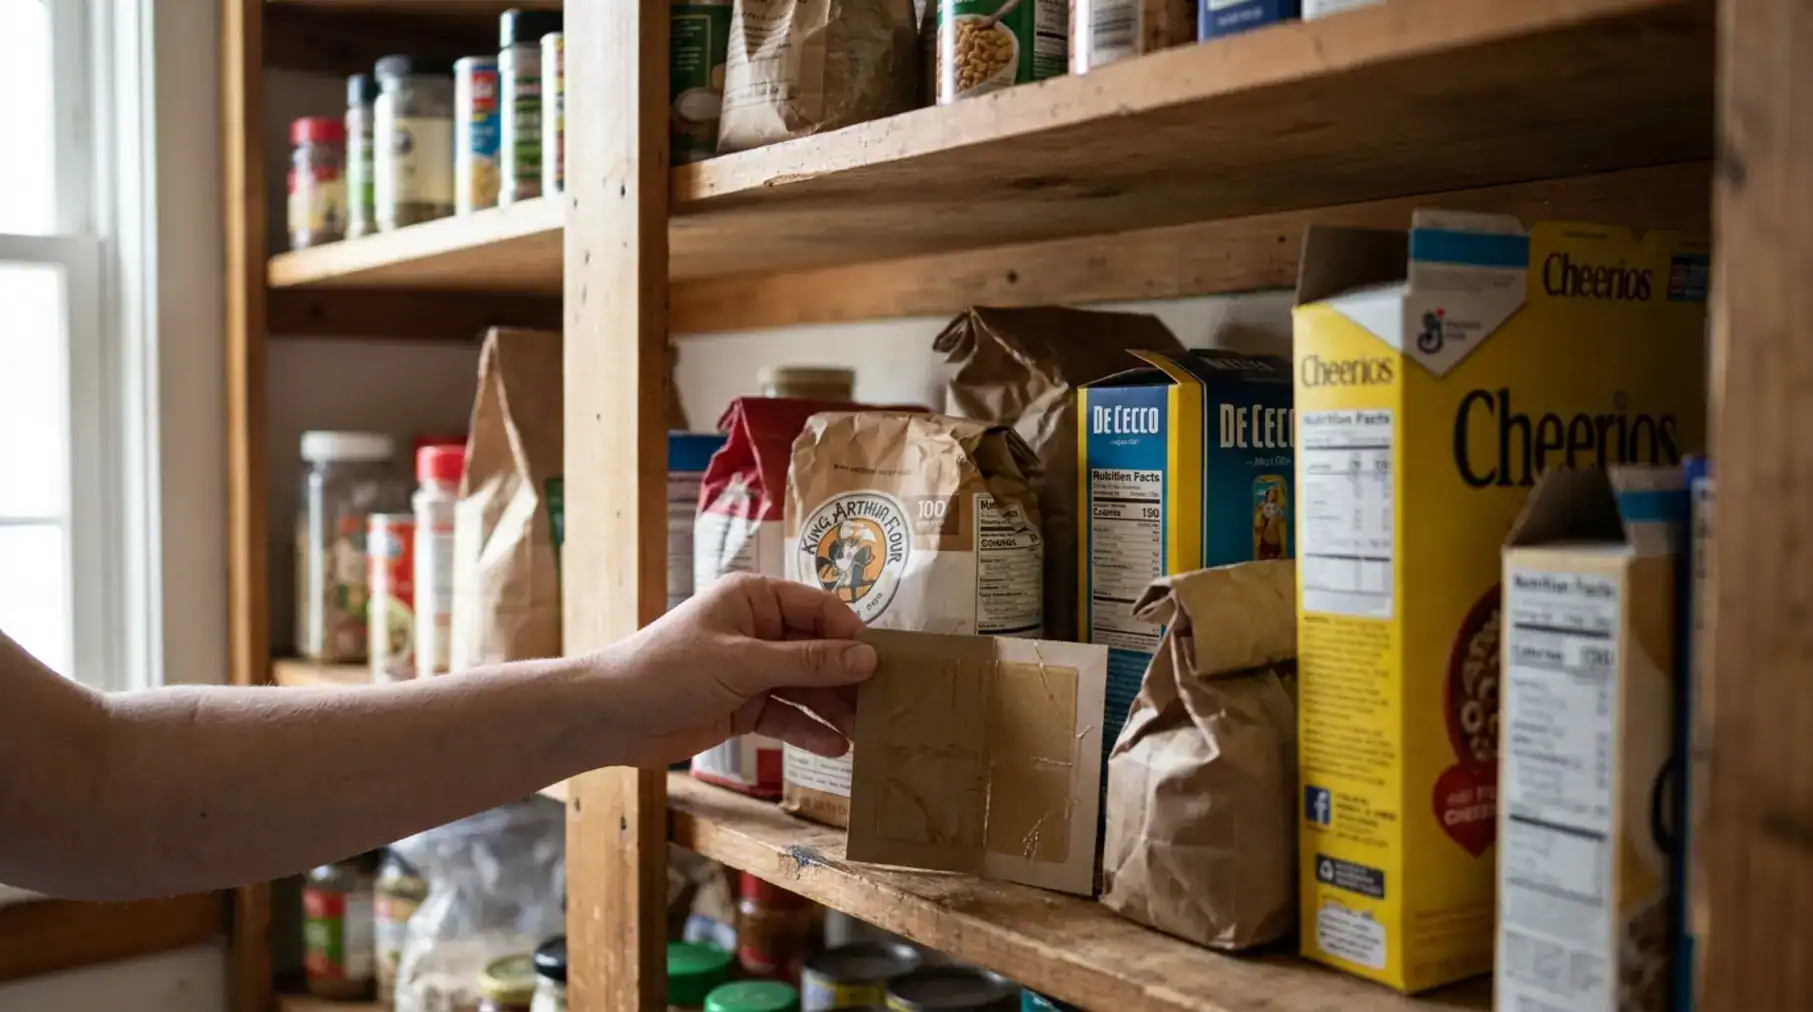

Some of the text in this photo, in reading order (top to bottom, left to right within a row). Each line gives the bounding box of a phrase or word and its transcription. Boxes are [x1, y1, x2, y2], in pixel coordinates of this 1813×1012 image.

[1543, 251, 1652, 301] Cheerios
[1301, 353, 1393, 388] Cheerios
[1454, 387, 1680, 488] Cheerios
[1134, 472, 1160, 483] Facts
[801, 515, 832, 555] KING
[832, 500, 890, 524] ARTHUR
[918, 500, 946, 518] 100
